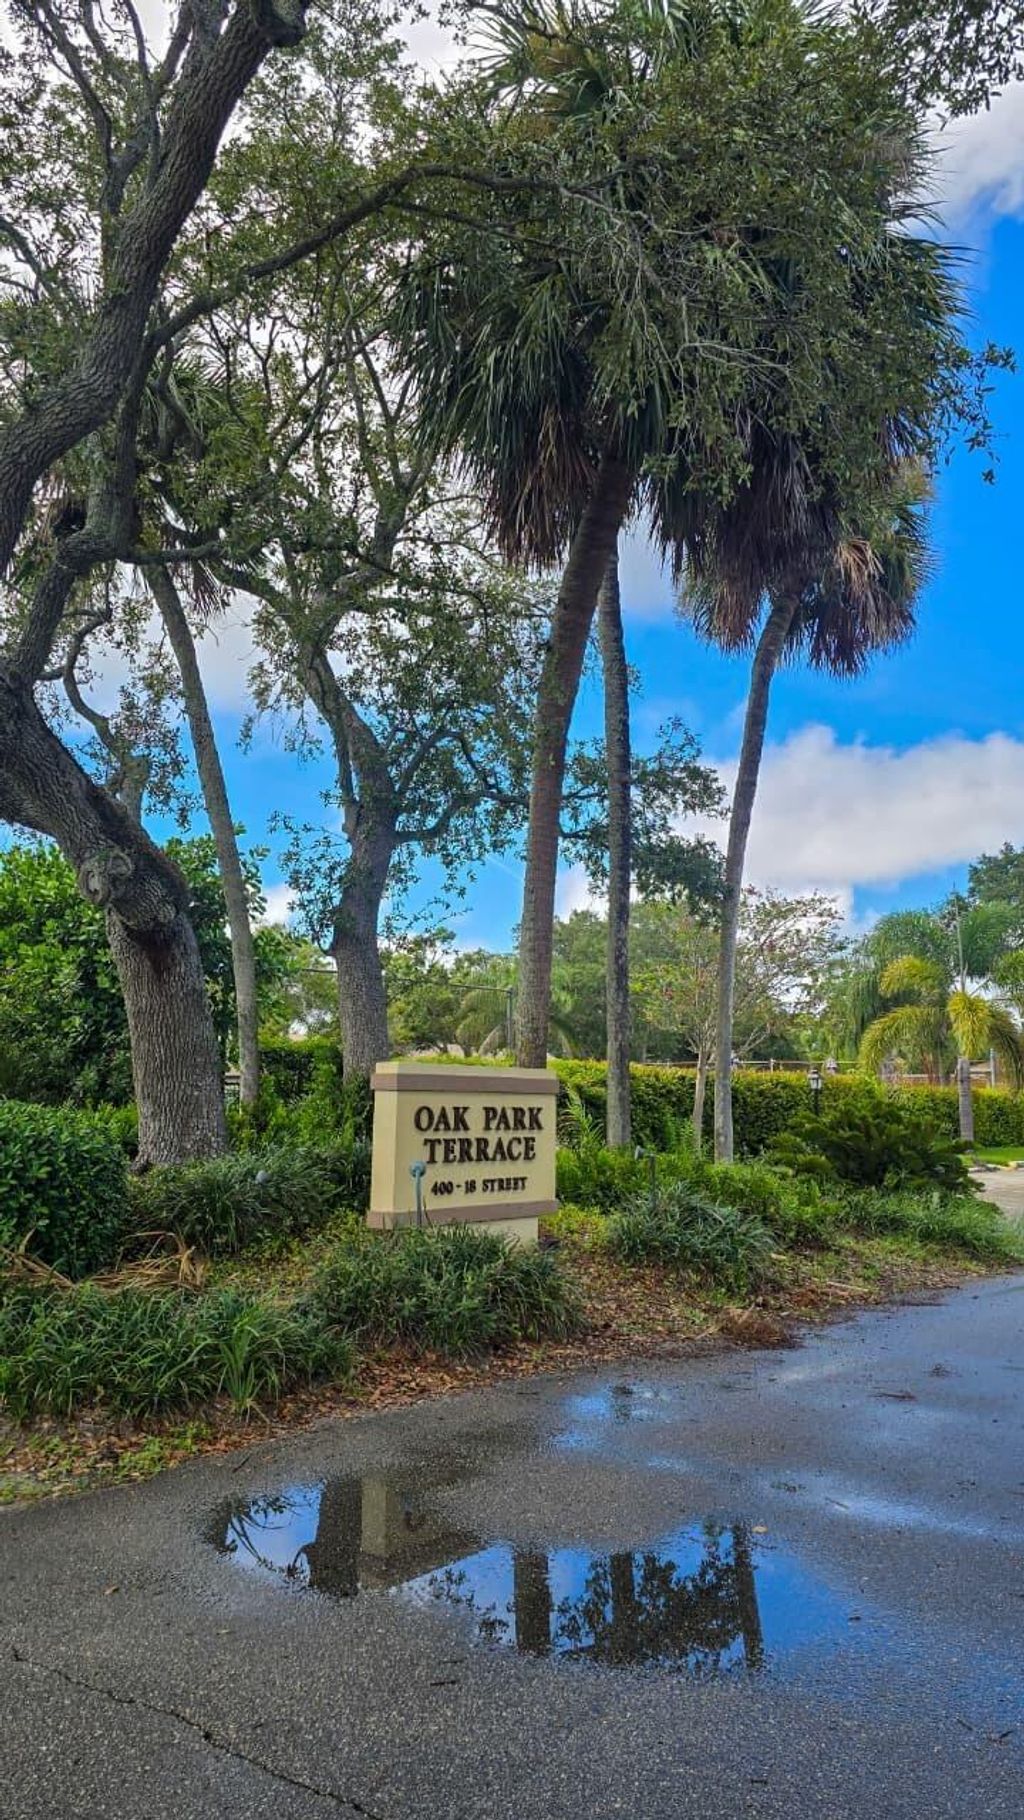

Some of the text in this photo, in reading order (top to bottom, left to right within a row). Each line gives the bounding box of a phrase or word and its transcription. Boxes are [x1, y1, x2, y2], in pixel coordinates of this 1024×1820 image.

[414, 1106, 543, 1131] OAK PARK
[423, 1137, 536, 1163] TERRACE
[482, 1176, 528, 1192] STREET
